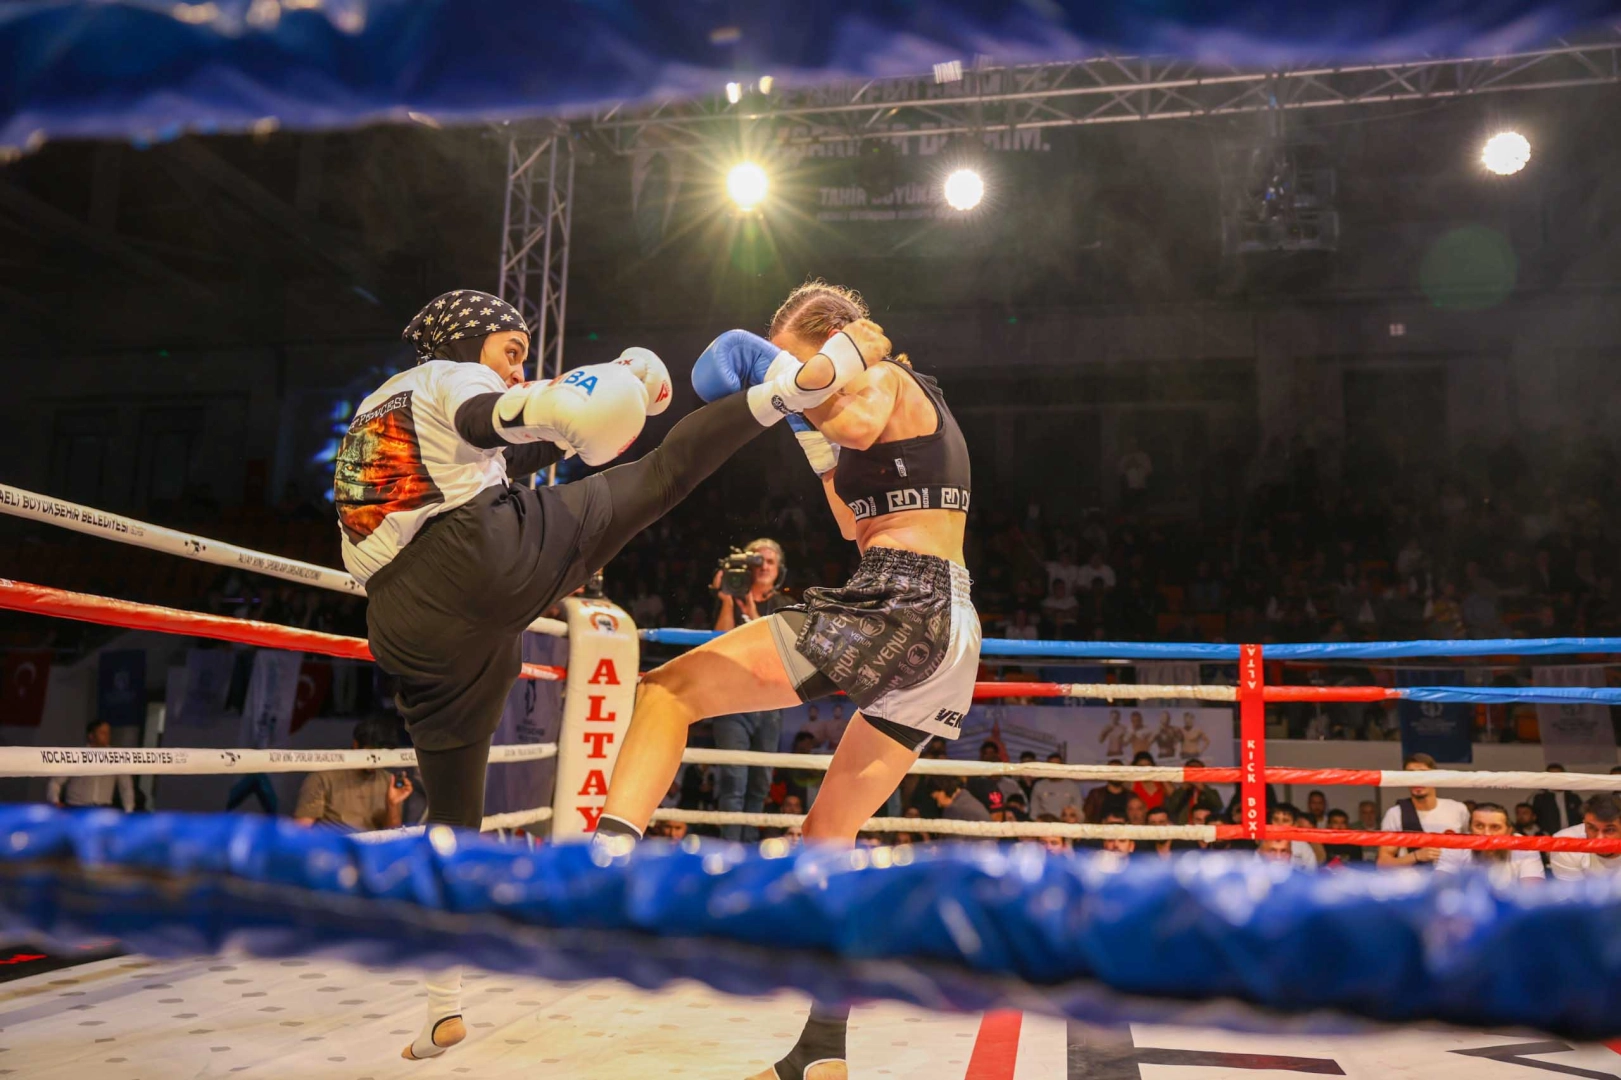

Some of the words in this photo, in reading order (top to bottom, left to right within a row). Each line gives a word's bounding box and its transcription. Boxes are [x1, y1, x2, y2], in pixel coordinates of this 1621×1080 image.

[872, 622, 913, 666] VENUM
[1246, 644, 1257, 690] ALTA
[576, 658, 621, 833] ALTAY
[1246, 740, 1256, 783] KICK
